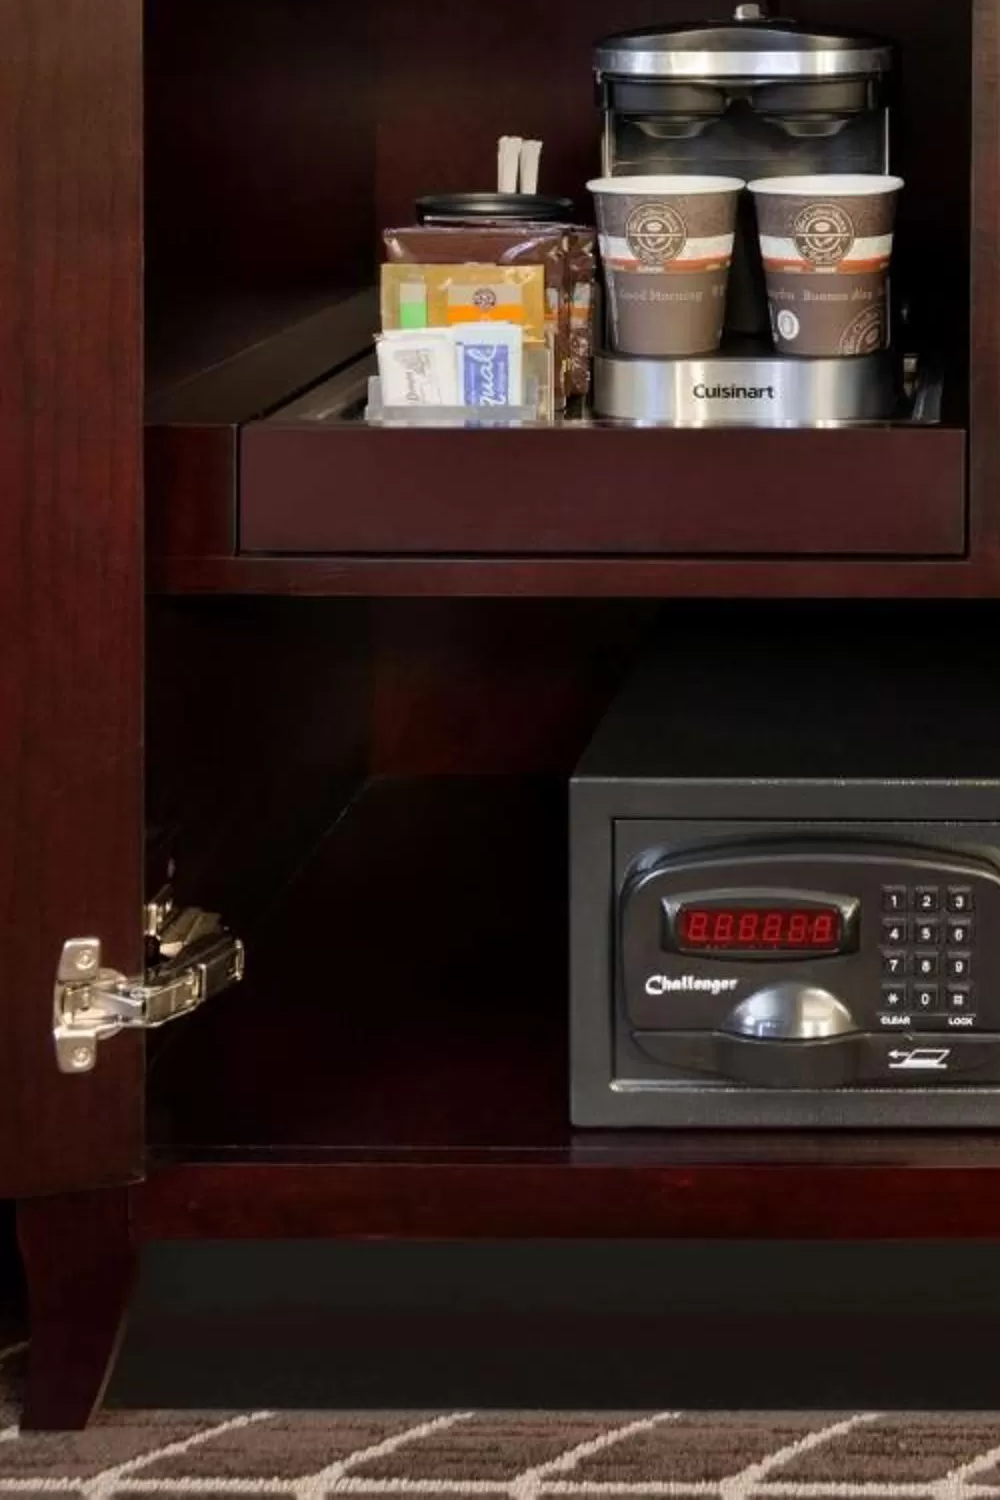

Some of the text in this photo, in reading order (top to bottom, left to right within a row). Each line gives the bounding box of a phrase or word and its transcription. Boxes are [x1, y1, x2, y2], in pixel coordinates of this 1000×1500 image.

[693, 384, 774, 400] Cuisinart
[890, 894, 964, 909] 1 2 3
[889, 926, 964, 942] 4 5 6
[889, 958, 964, 973] 7 8 9
[645, 974, 739, 996] Challenger
[920, 992, 930, 1006] 0
[880, 1015, 973, 1026] CLEAR LOCK
